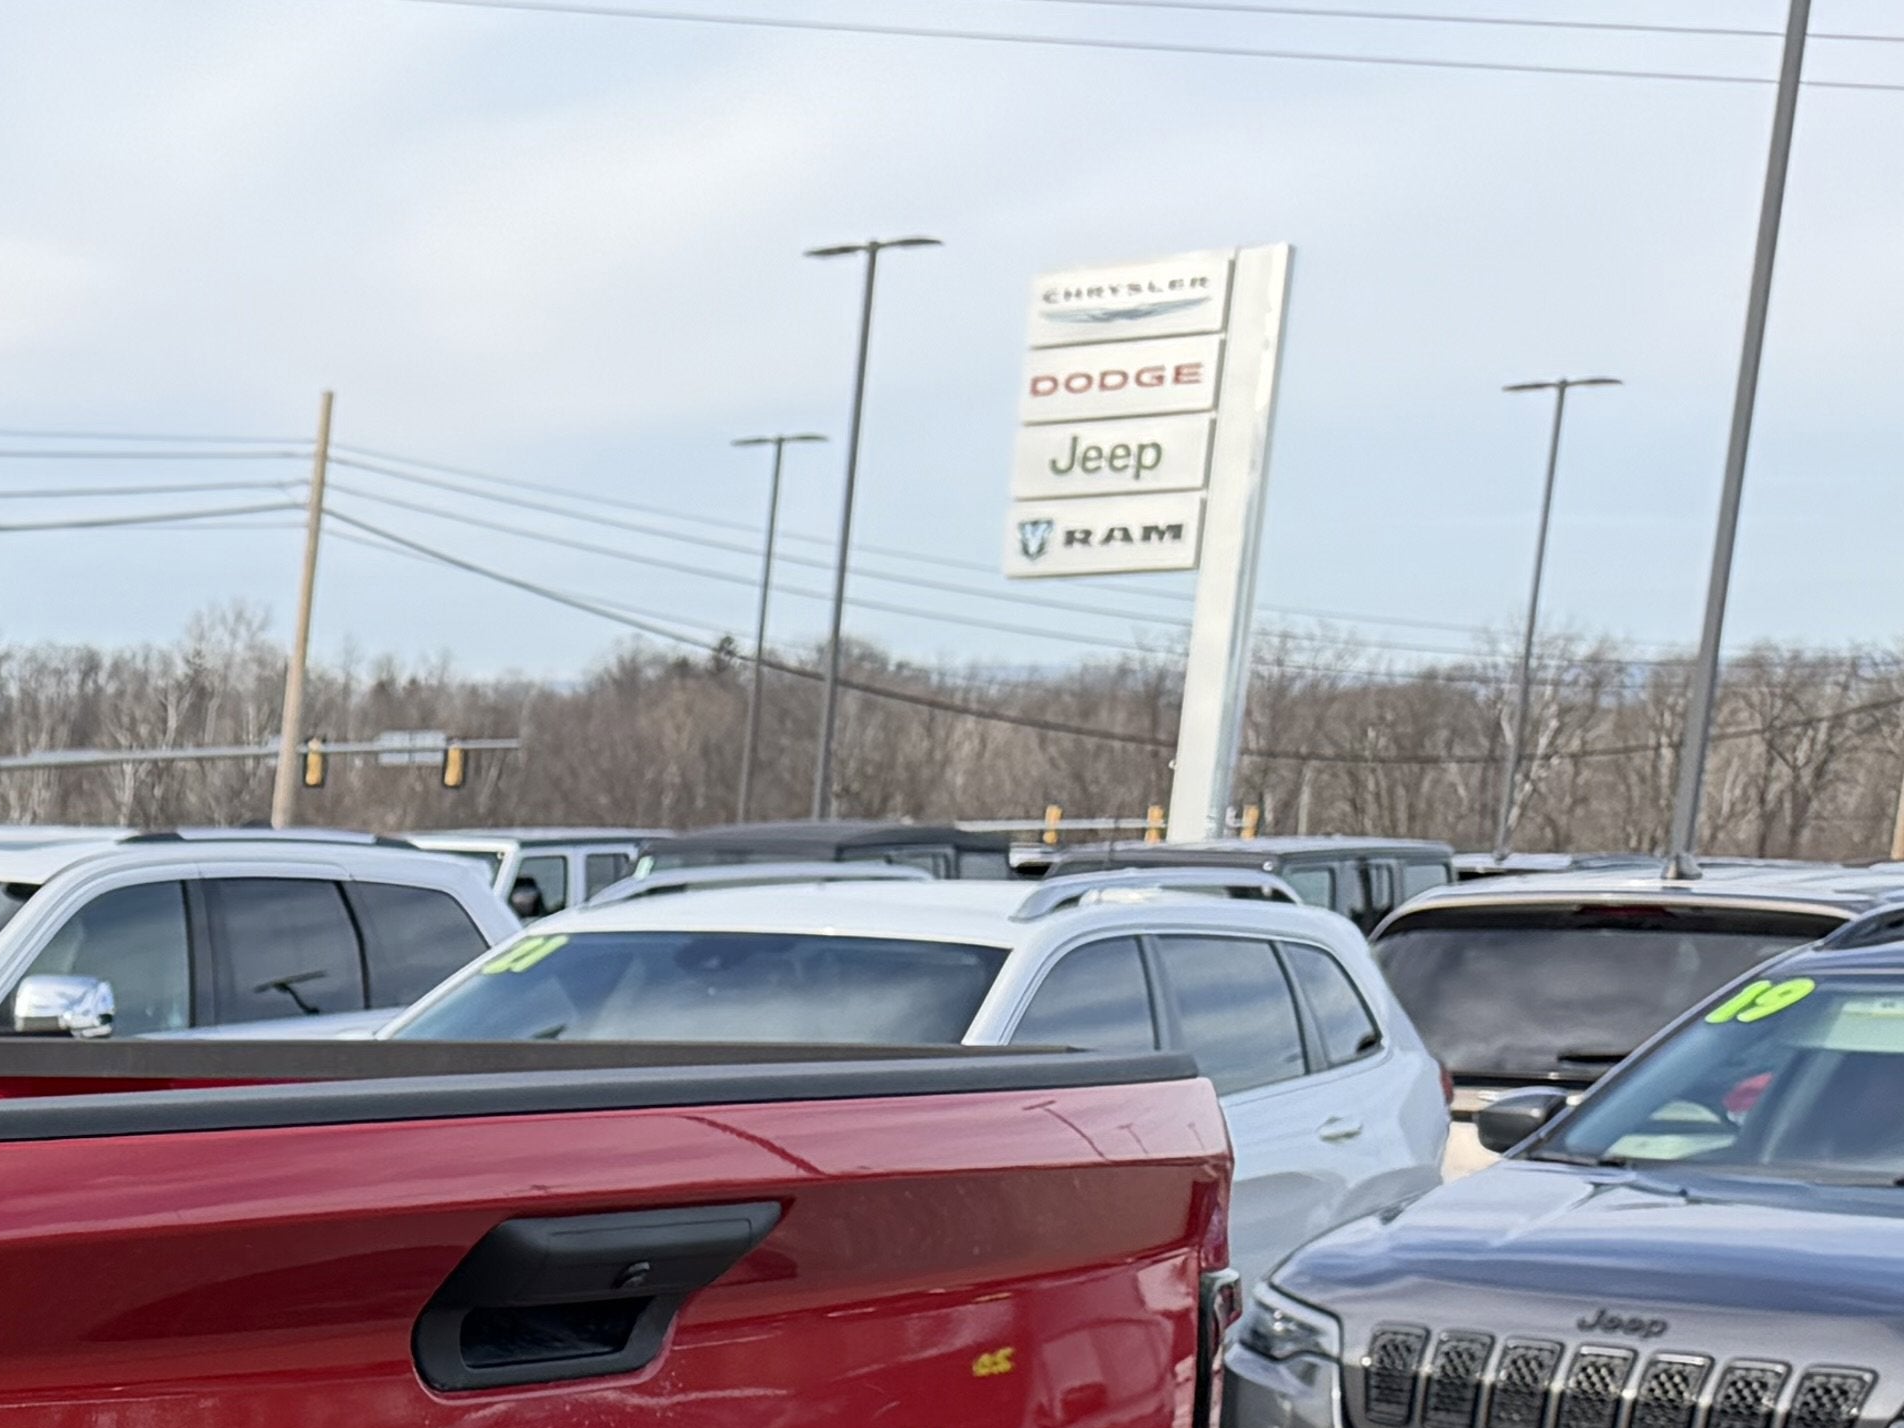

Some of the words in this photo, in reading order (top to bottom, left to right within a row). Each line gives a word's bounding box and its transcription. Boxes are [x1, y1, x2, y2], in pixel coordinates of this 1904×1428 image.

[1042, 274, 1210, 303] CHRYSLER
[1029, 362, 1203, 398] DODGE
[1049, 435, 1163, 480] Jeep
[1063, 522, 1184, 549] RAM
[1704, 977, 1816, 1024] 19
[1576, 1308, 1668, 1340] Jeep
